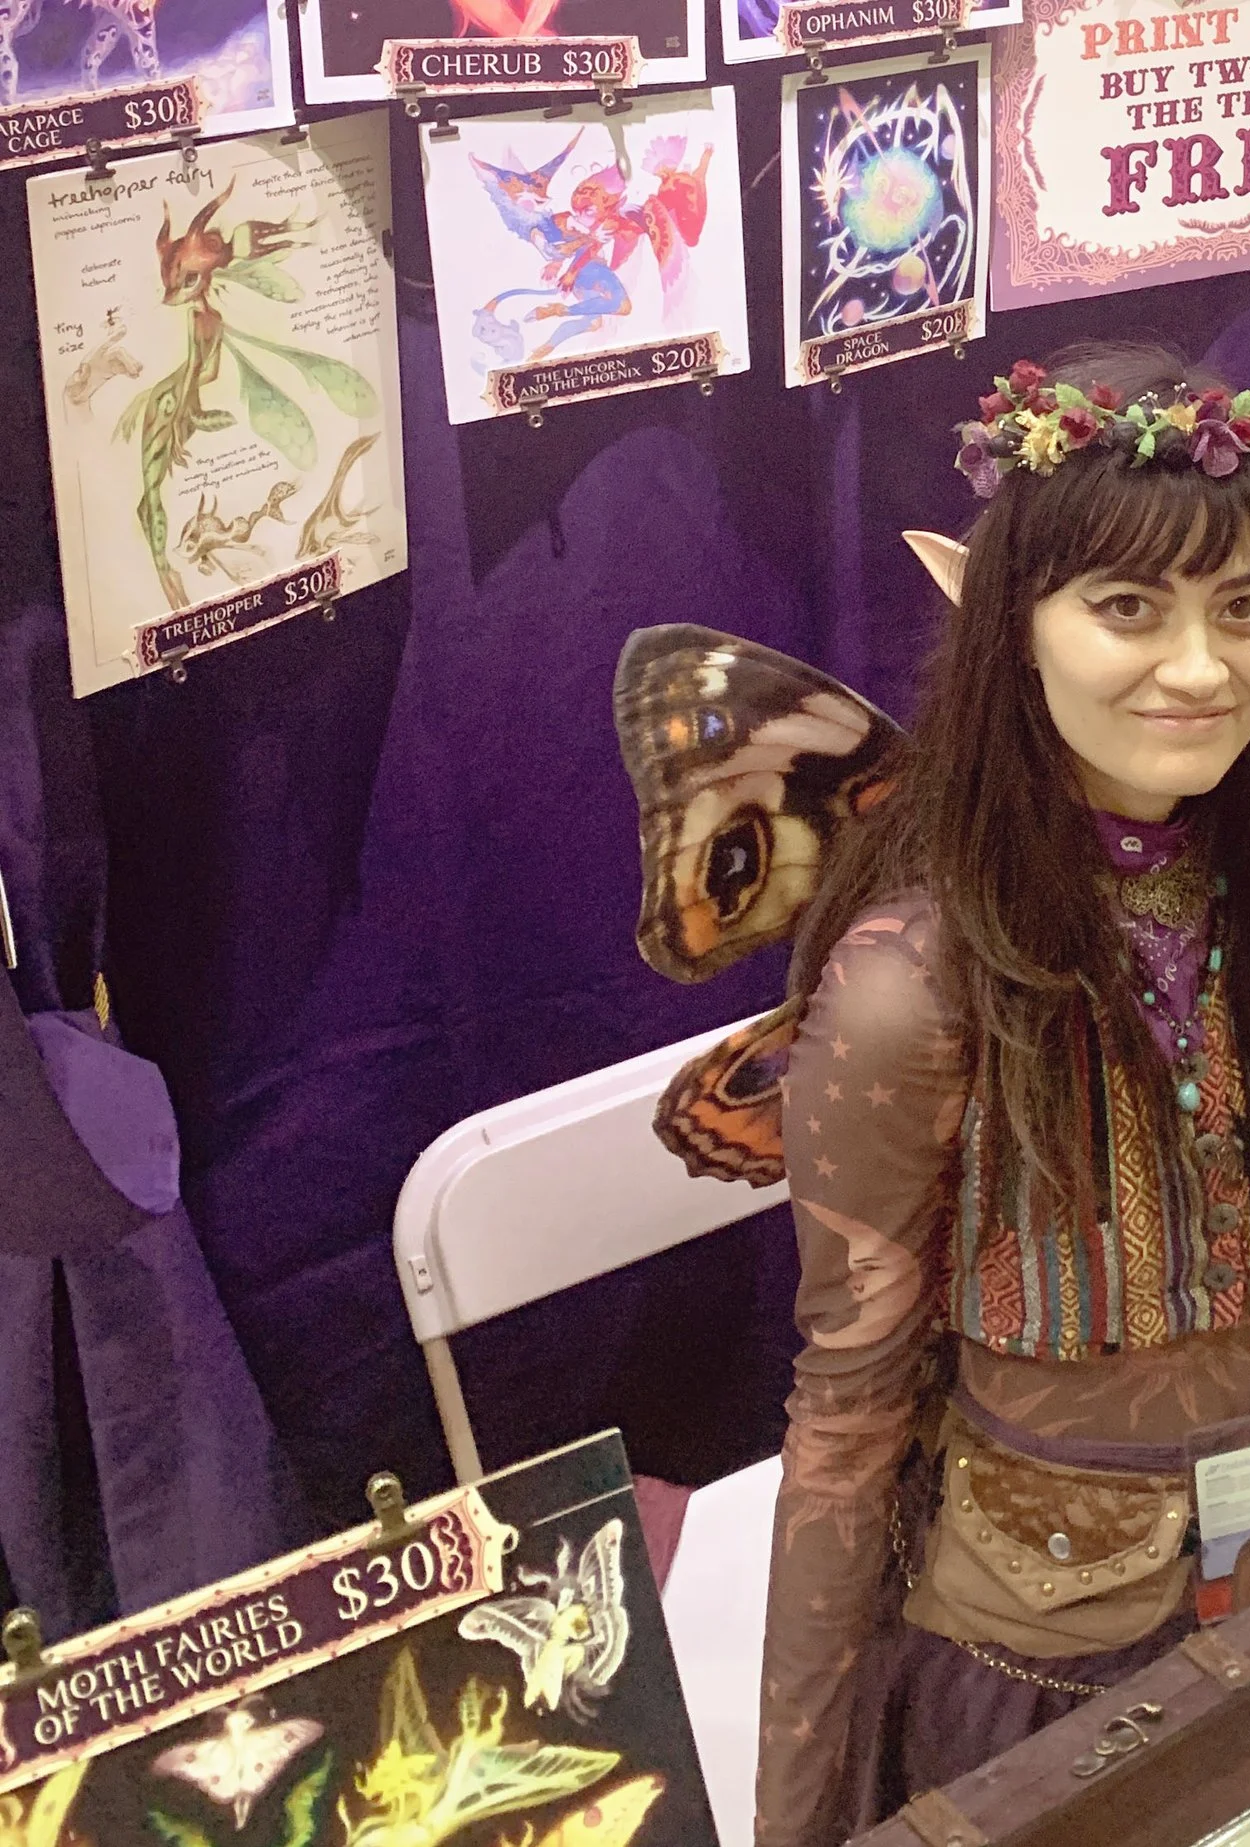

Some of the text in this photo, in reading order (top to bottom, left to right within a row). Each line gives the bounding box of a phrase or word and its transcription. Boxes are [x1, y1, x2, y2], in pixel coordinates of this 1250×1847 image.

[806, 0, 948, 35] OPHANIM $30
[1079, 5, 1240, 61] PRINT
[421, 49, 611, 78] CHERUB $30
[1099, 64, 1171, 100] BUY
[124, 96, 175, 130] $30
[1127, 95, 1204, 131] THE
[8, 129, 62, 153] CAGE
[48, 167, 214, 208] treehopper fairy
[53, 322, 84, 338] tiny
[836, 315, 954, 366] DRAGON $20
[843, 331, 883, 351] SPACE
[58, 341, 85, 355] size
[520, 347, 695, 398] AND THE PHOENIX $20
[533, 359, 626, 384] THE UNICORN
[163, 571, 323, 641] TREEHOPPER $30
[191, 617, 237, 645] FAIRY
[32, 1541, 436, 1747] OF THE WORLD $30
[36, 1595, 290, 1714] MOTH FAIRIES
